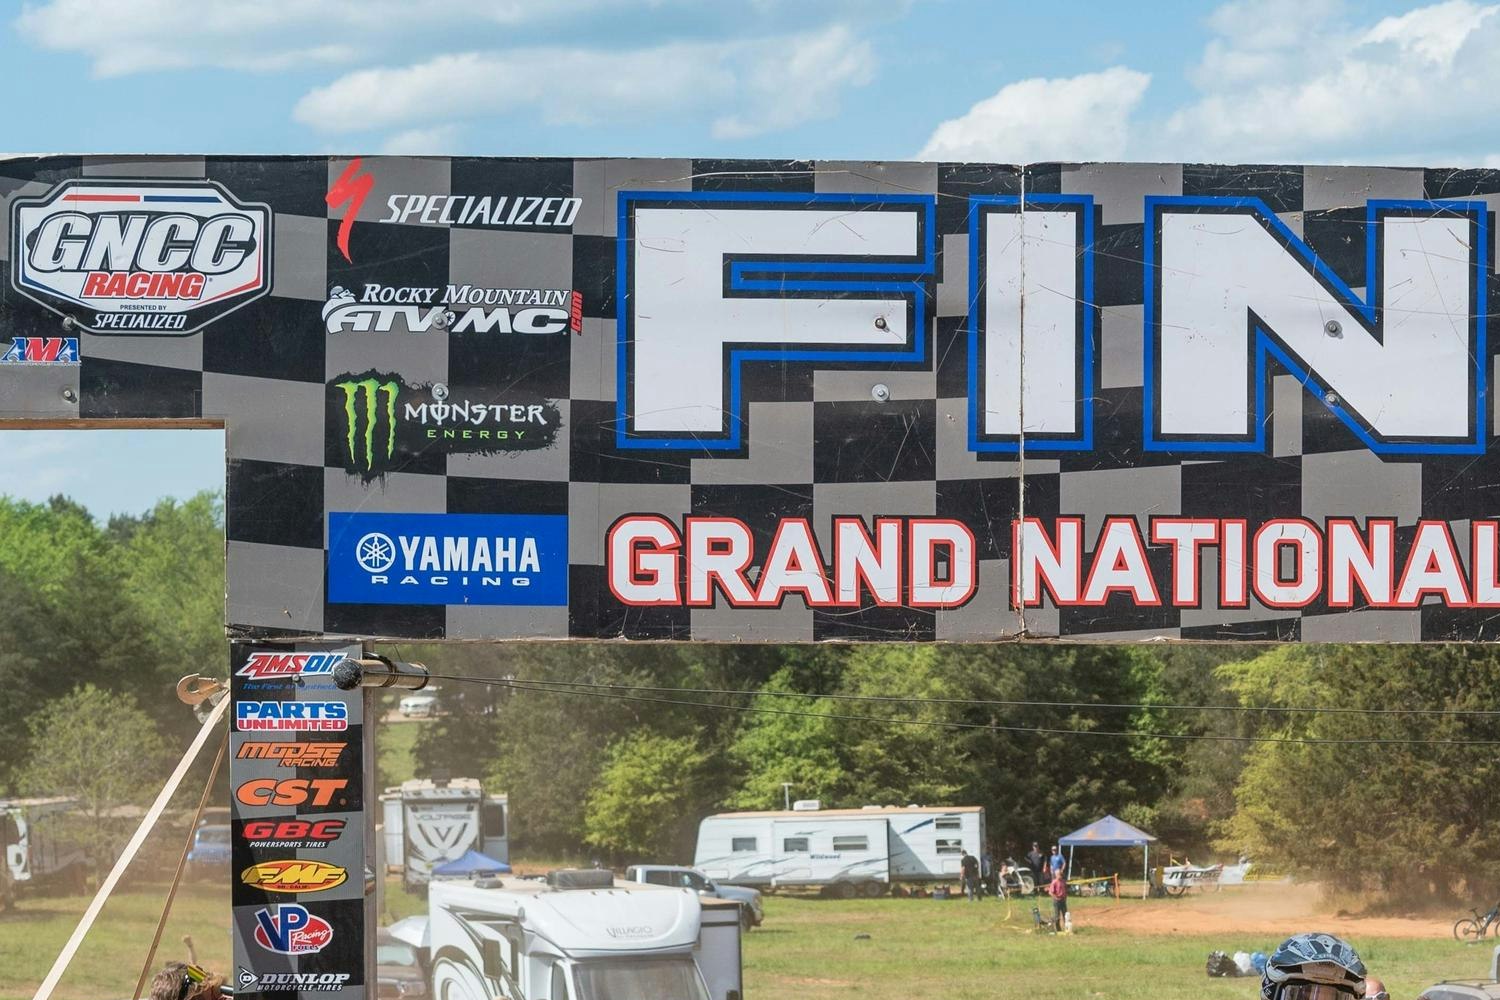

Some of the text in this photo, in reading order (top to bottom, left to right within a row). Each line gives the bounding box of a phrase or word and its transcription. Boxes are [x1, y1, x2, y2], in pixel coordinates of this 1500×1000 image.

[380, 195, 582, 226] SPECIALIZED
[28, 211, 255, 275] GNCC
[80, 272, 206, 300] RACING
[360, 283, 571, 306] ROCKY MOUNTAIN
[91, 313, 188, 330] SPECIALIZED
[1, 337, 81, 363] AMA
[404, 399, 548, 426] MONSTER
[427, 429, 526, 440] ENERGY
[398, 536, 541, 573] YAMAHA
[606, 514, 981, 610] GRAND
[371, 575, 530, 586] RACING
[238, 702, 347, 719] PARTS
[238, 720, 347, 731] UNLIMITED
[236, 742, 347, 759] MOOSE
[279, 758, 339, 767] RACING
[242, 820, 347, 840] GBC
[242, 864, 345, 884] FMF
[255, 904, 310, 952] VP
[259, 973, 350, 984] DUNLOP
